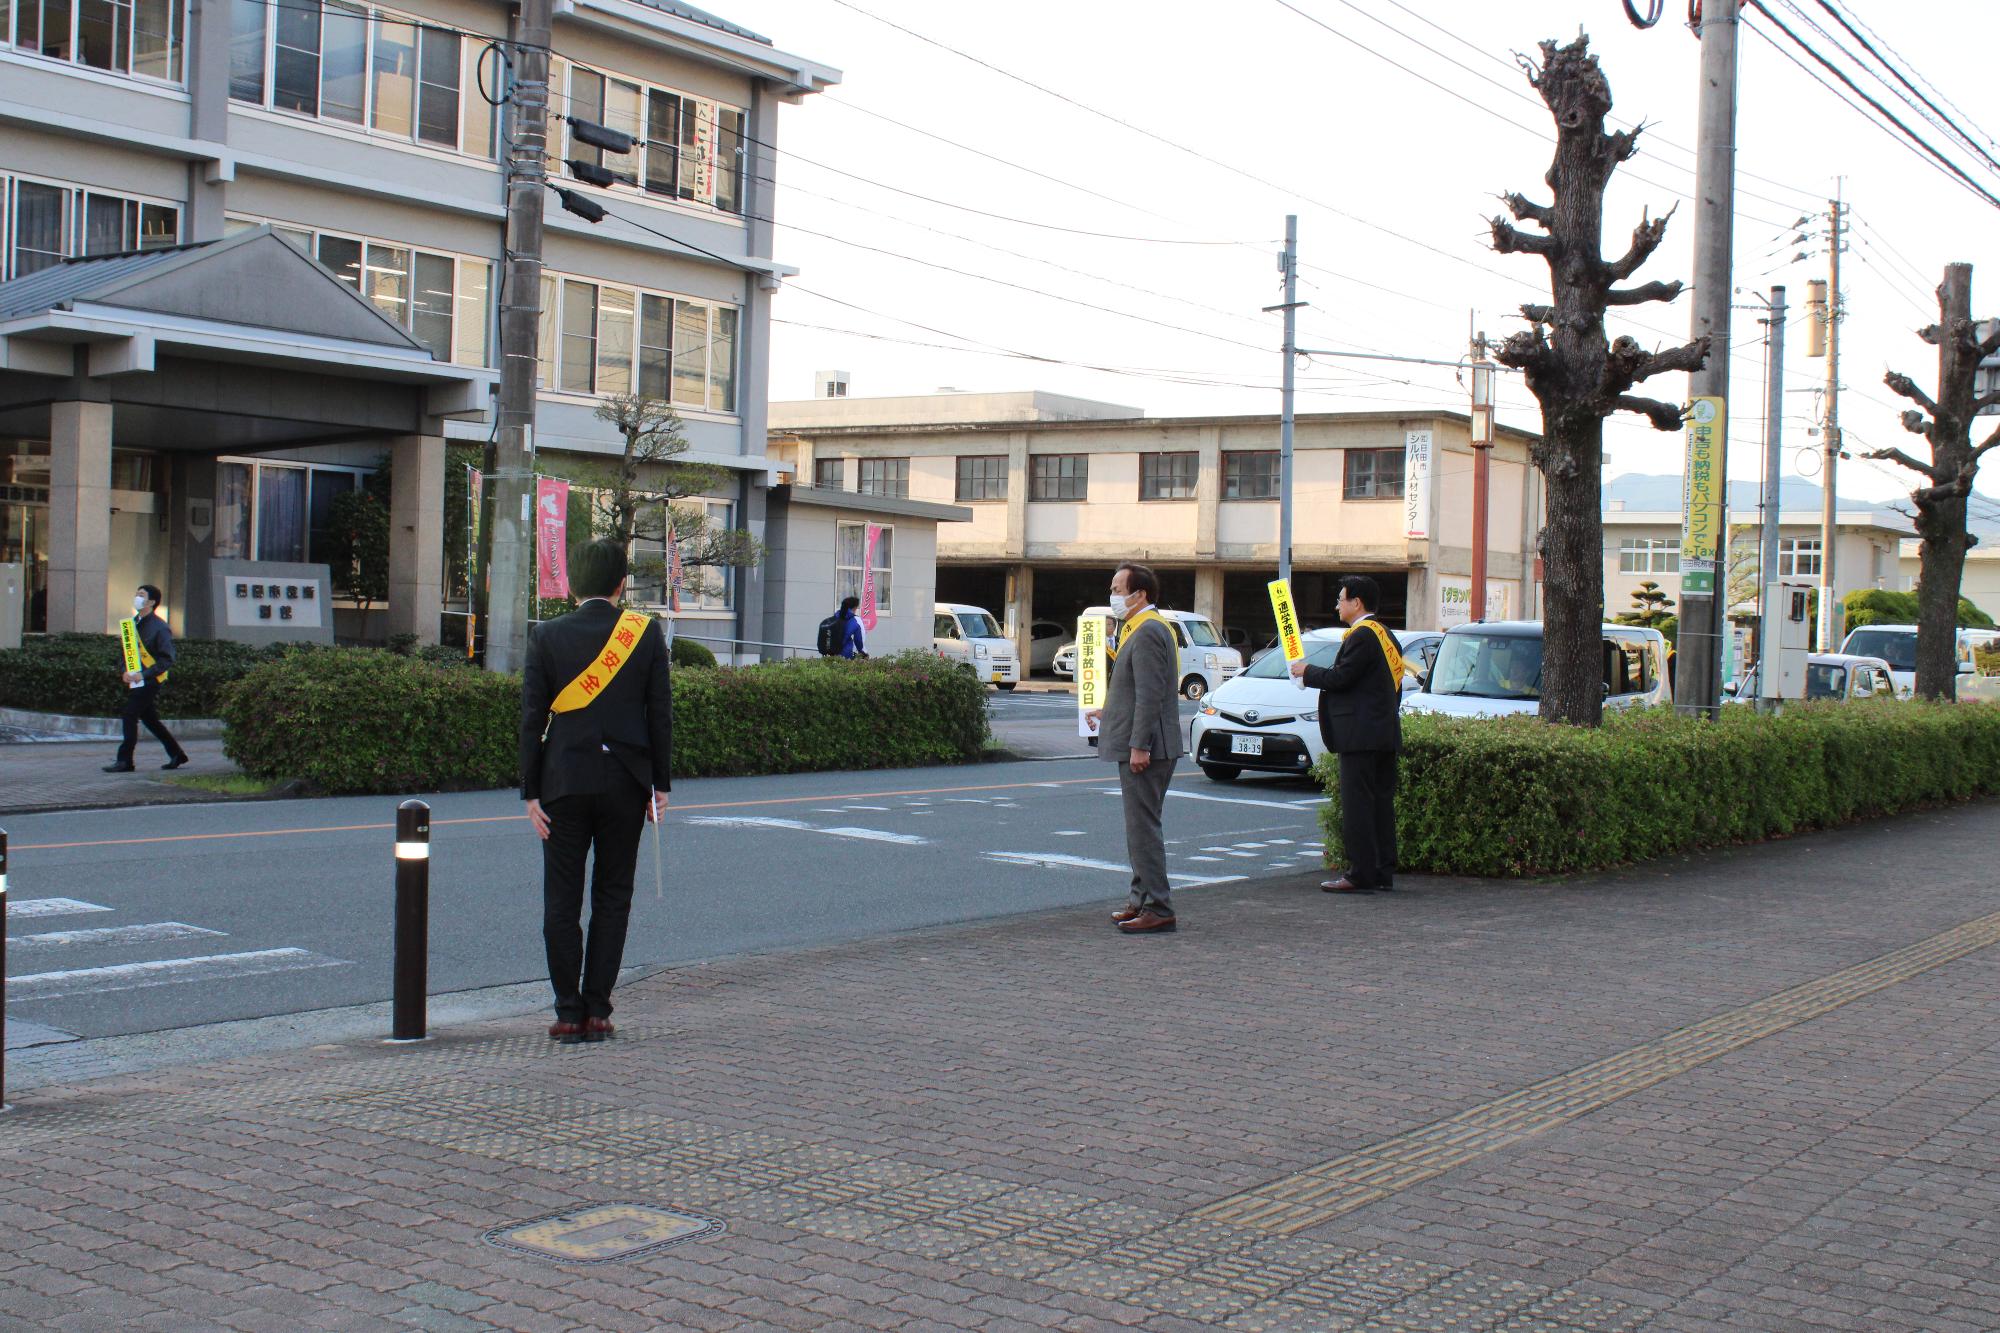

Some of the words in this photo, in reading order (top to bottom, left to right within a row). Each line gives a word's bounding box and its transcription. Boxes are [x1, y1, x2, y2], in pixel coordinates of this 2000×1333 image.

[1408, 435, 1420, 529] シルバー人材センター
[1684, 546, 1715, 557] e-Tax
[579, 614, 644, 696] 交通安全
[1278, 601, 1299, 659] 通学路注意
